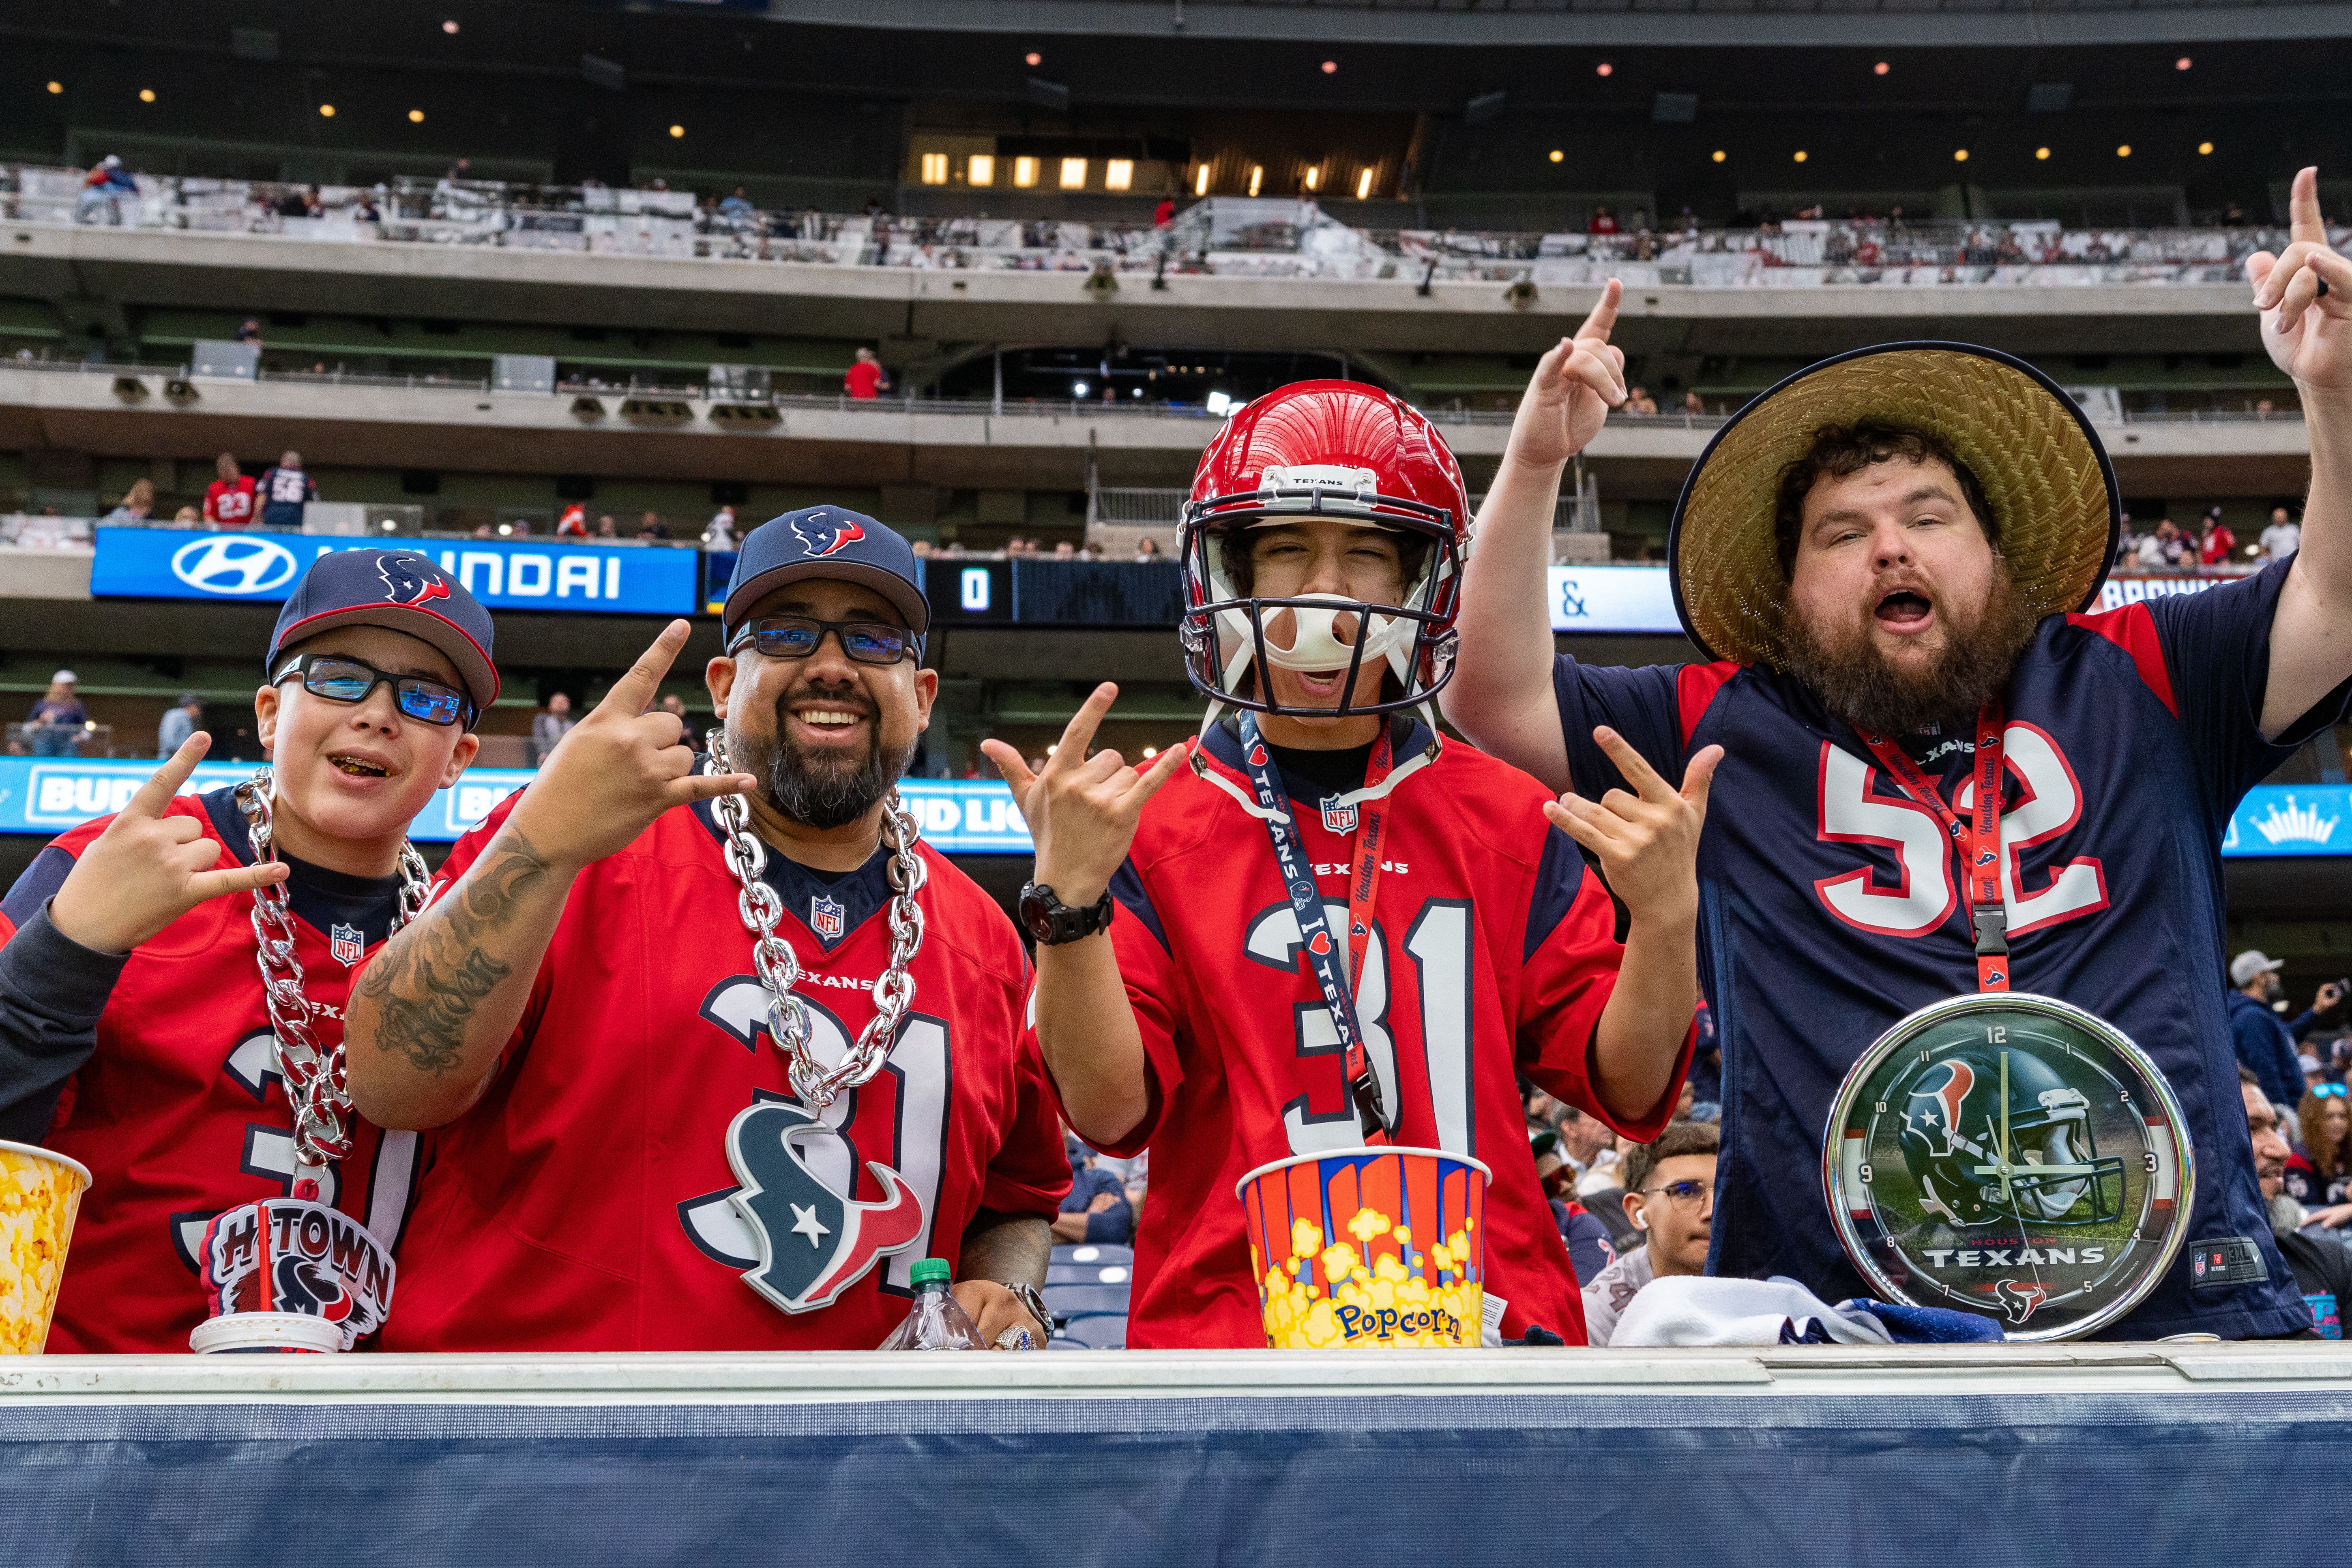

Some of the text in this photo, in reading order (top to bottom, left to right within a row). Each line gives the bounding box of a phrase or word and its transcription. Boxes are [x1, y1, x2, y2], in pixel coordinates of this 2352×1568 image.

[1293, 477, 1343, 486] TEXANS
[317, 545, 620, 599] NDAI
[961, 568, 990, 611] 0
[1562, 580, 1589, 617] &
[1277, 794, 1297, 847] HOTON
[1328, 811, 1354, 828] NFL
[1979, 793, 1994, 835] Houston
[1813, 720, 2111, 943] 52
[1309, 860, 1409, 875] EXNS
[1355, 854, 1376, 903] Houston
[816, 912, 839, 933] NFL
[337, 940, 360, 958] NFL
[1318, 958, 1355, 1052] TEXA
[1243, 897, 1476, 1157] 31
[1987, 1026, 2007, 1044] 12
[1921, 1051, 1930, 1062] 11
[2066, 1043, 2070, 1054] 1
[2120, 1090, 2129, 1102] 2
[1875, 1101, 1887, 1113] 10
[2144, 1154, 2157, 1172] 3
[1860, 1165, 1873, 1182] 9
[1886, 1236, 1895, 1248] 8
[1970, 1237, 2056, 1246] HOUSTON
[2133, 1229, 2140, 1240] 4
[1922, 1247, 2105, 1268] TEXANS
[1942, 1284, 1950, 1296] 7
[2084, 1281, 2092, 1293] 5
[1335, 1305, 1462, 1343] Popcorn
